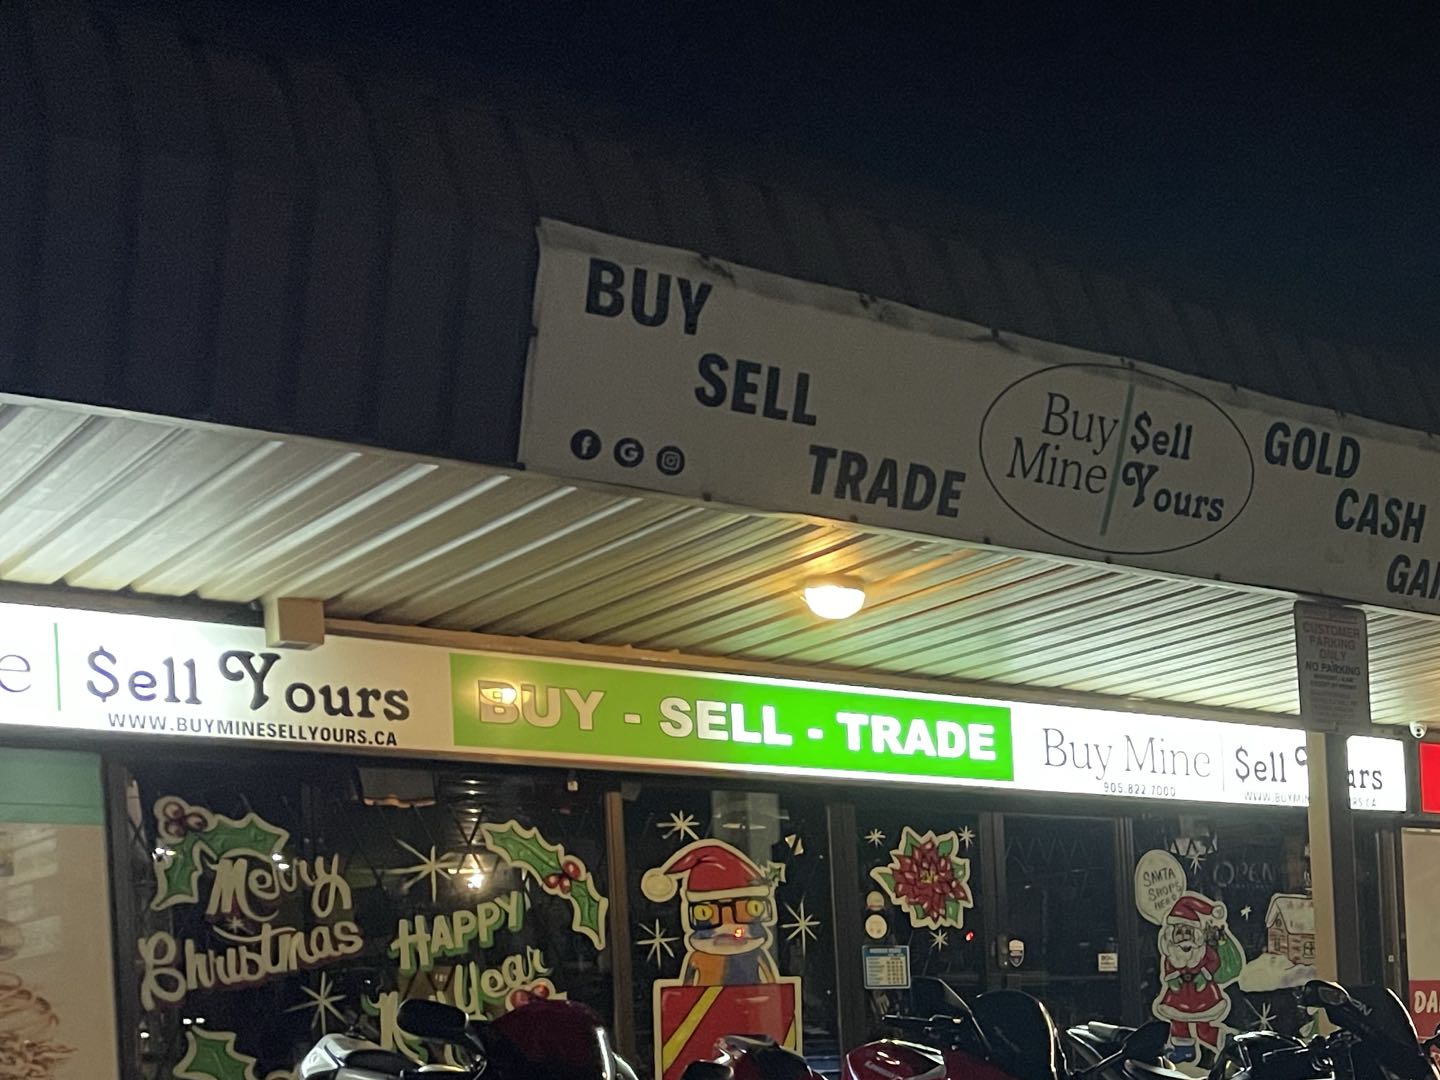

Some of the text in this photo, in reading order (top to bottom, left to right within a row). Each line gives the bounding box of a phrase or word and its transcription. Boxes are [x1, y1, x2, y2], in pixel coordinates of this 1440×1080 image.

[585, 257, 713, 335] BUY
[694, 353, 817, 426] SELL
[1042, 392, 1119, 455] Buy
[1264, 421, 1361, 478] GOLD
[808, 444, 966, 518] TRADE
[1006, 437, 1224, 522] Mine Yours
[1334, 488, 1426, 543] CASH
[1303, 622, 1360, 639] CUSTOMER
[1309, 635, 1356, 651] PARKING
[1319, 649, 1346, 661] ONLY
[218, 650, 410, 721] Yours
[1305, 661, 1361, 676] NO PARKING
[108, 712, 397, 746] WWW.BUYMINESELLYOURS.CA
[478, 680, 606, 731] BUY
[659, 697, 793, 746] SELL
[836, 711, 997, 761] TRADE
[1042, 728, 1112, 780] Buy
[1125, 735, 1210, 777] Mine
[205, 853, 352, 921] Merry
[1142, 867, 1176, 887] SANTA
[1148, 880, 1182, 901] SHOPS
[389, 890, 522, 971] HAPPY
[138, 921, 363, 1012] Christmas
[454, 945, 552, 1020] Year
